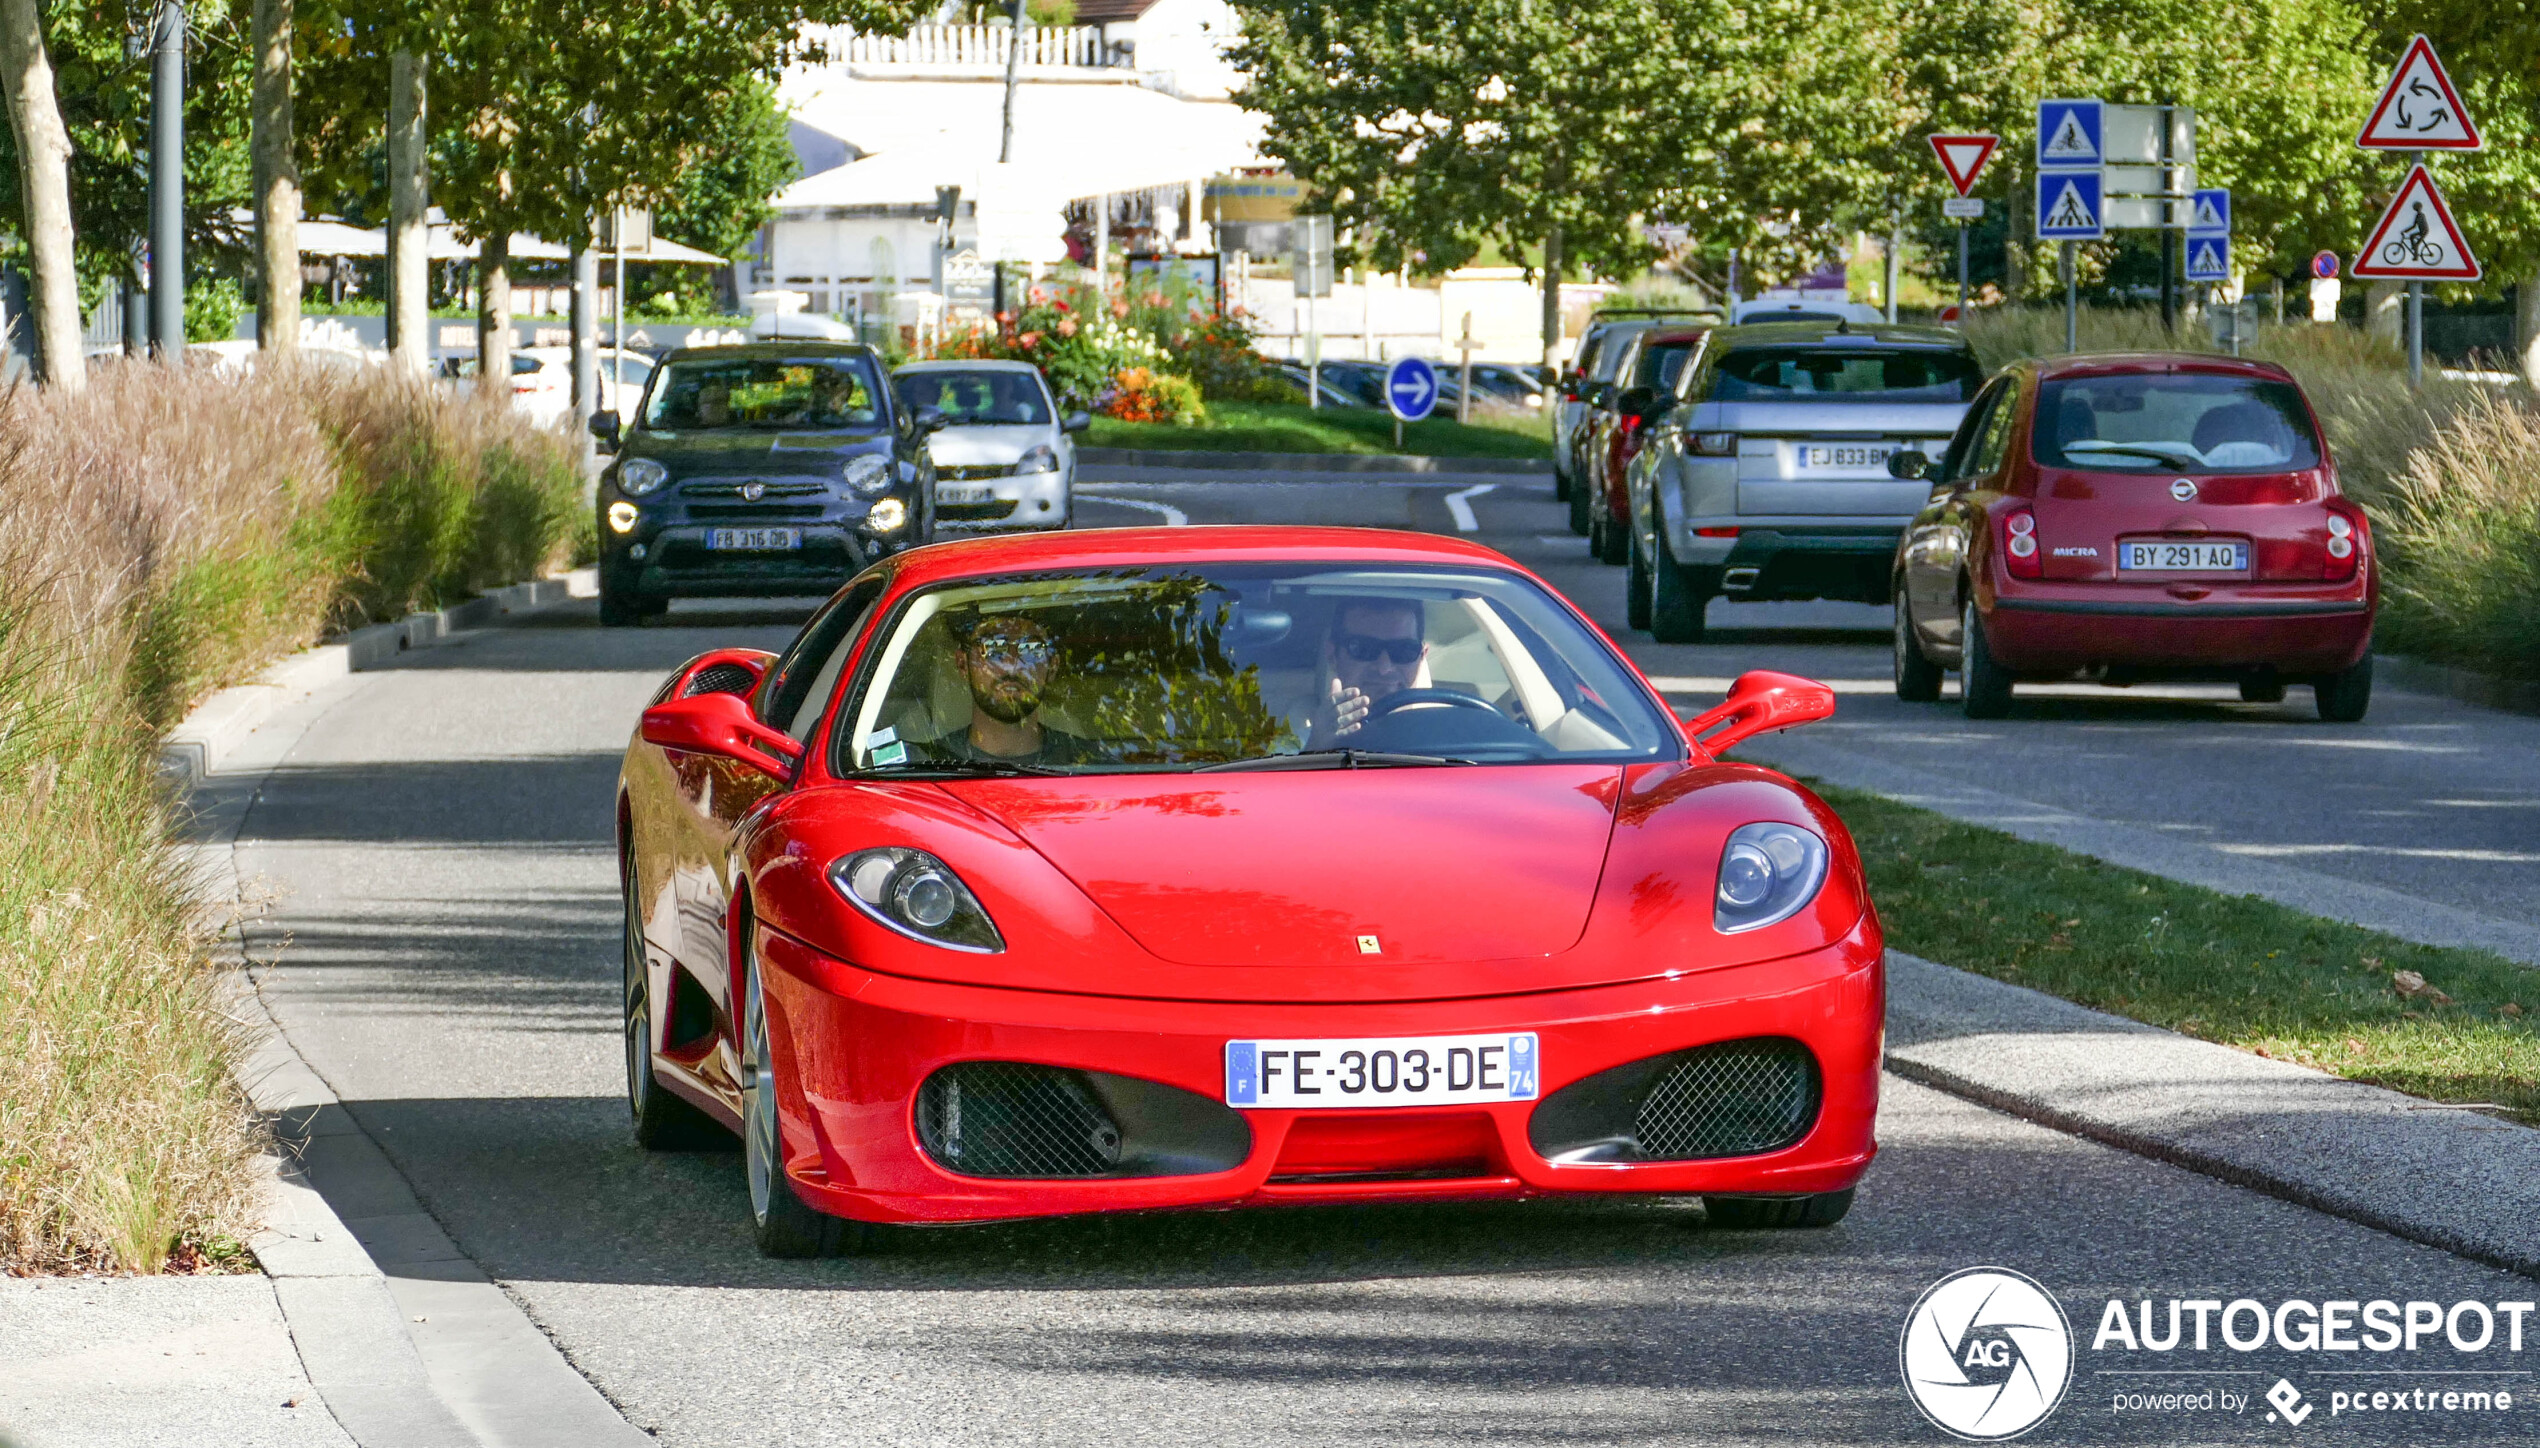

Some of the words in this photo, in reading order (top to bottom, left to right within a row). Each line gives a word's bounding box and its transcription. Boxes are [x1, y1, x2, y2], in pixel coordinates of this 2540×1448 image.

[1812, 449, 1832, 465] EJ
[1836, 449, 1866, 465] 833
[2053, 547, 2098, 557] MICRA
[2134, 547, 2158, 566] BY
[2166, 547, 2200, 566] 291
[2208, 547, 2232, 567] AQ
[1261, 1045, 1505, 1095] FE-303-DE
[1238, 1079, 1248, 1094] F
[1510, 1069, 1534, 1093] 74
